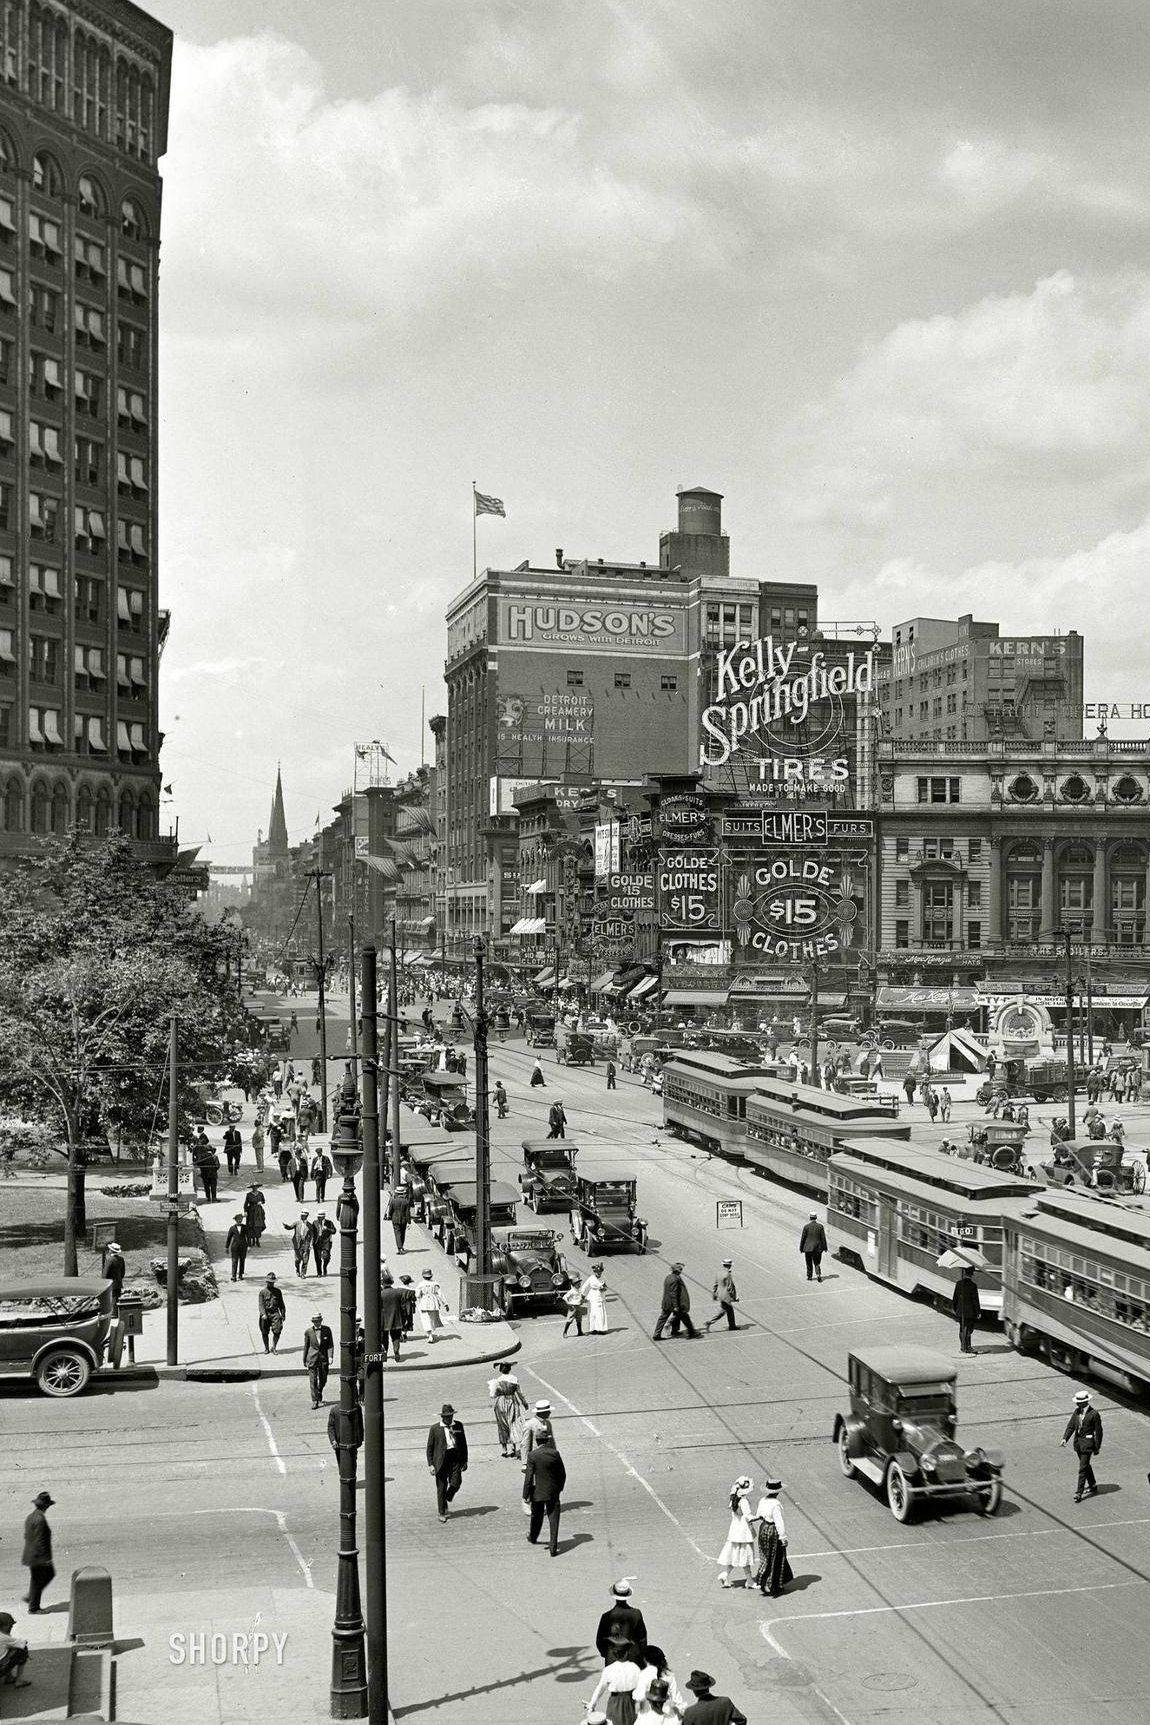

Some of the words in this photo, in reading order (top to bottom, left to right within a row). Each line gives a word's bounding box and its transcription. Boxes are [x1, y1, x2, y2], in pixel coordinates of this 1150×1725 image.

[508, 605, 676, 640] HUDSON'S
[542, 633, 585, 643] GROWS
[615, 637, 663, 647] DETROIT
[988, 641, 1066, 655] KERN'S
[715, 635, 809, 702] Kelly-
[543, 695, 587, 706] DETROIT
[537, 705, 593, 718] CREAMERY
[701, 651, 873, 765] Springfield
[545, 718, 585, 731] MILK
[548, 735, 595, 744] INSURANCE
[753, 758, 849, 780] TIRES
[750, 783, 774, 792] MADE
[778, 783, 790, 792] TO
[793, 783, 819, 792] MAKE
[822, 784, 846, 793] GOOD
[556, 800, 578, 808] DRY
[660, 812, 706, 823] ELMER'S
[725, 823, 760, 831] SUITS
[764, 813, 825, 842] ELMER'S
[833, 824, 866, 833] FURS
[667, 857, 708, 868] GOLDE
[755, 860, 834, 886] GOLDE
[611, 875, 653, 888] GOLDE
[660, 873, 717, 892] CLOTHES
[622, 886, 640, 896] $15
[611, 897, 654, 908] CLOTHES
[671, 895, 705, 920] $15
[769, 899, 817, 924] $15
[752, 932, 839, 959] CLOTHES
[364, 1353, 383, 1362] FORT
